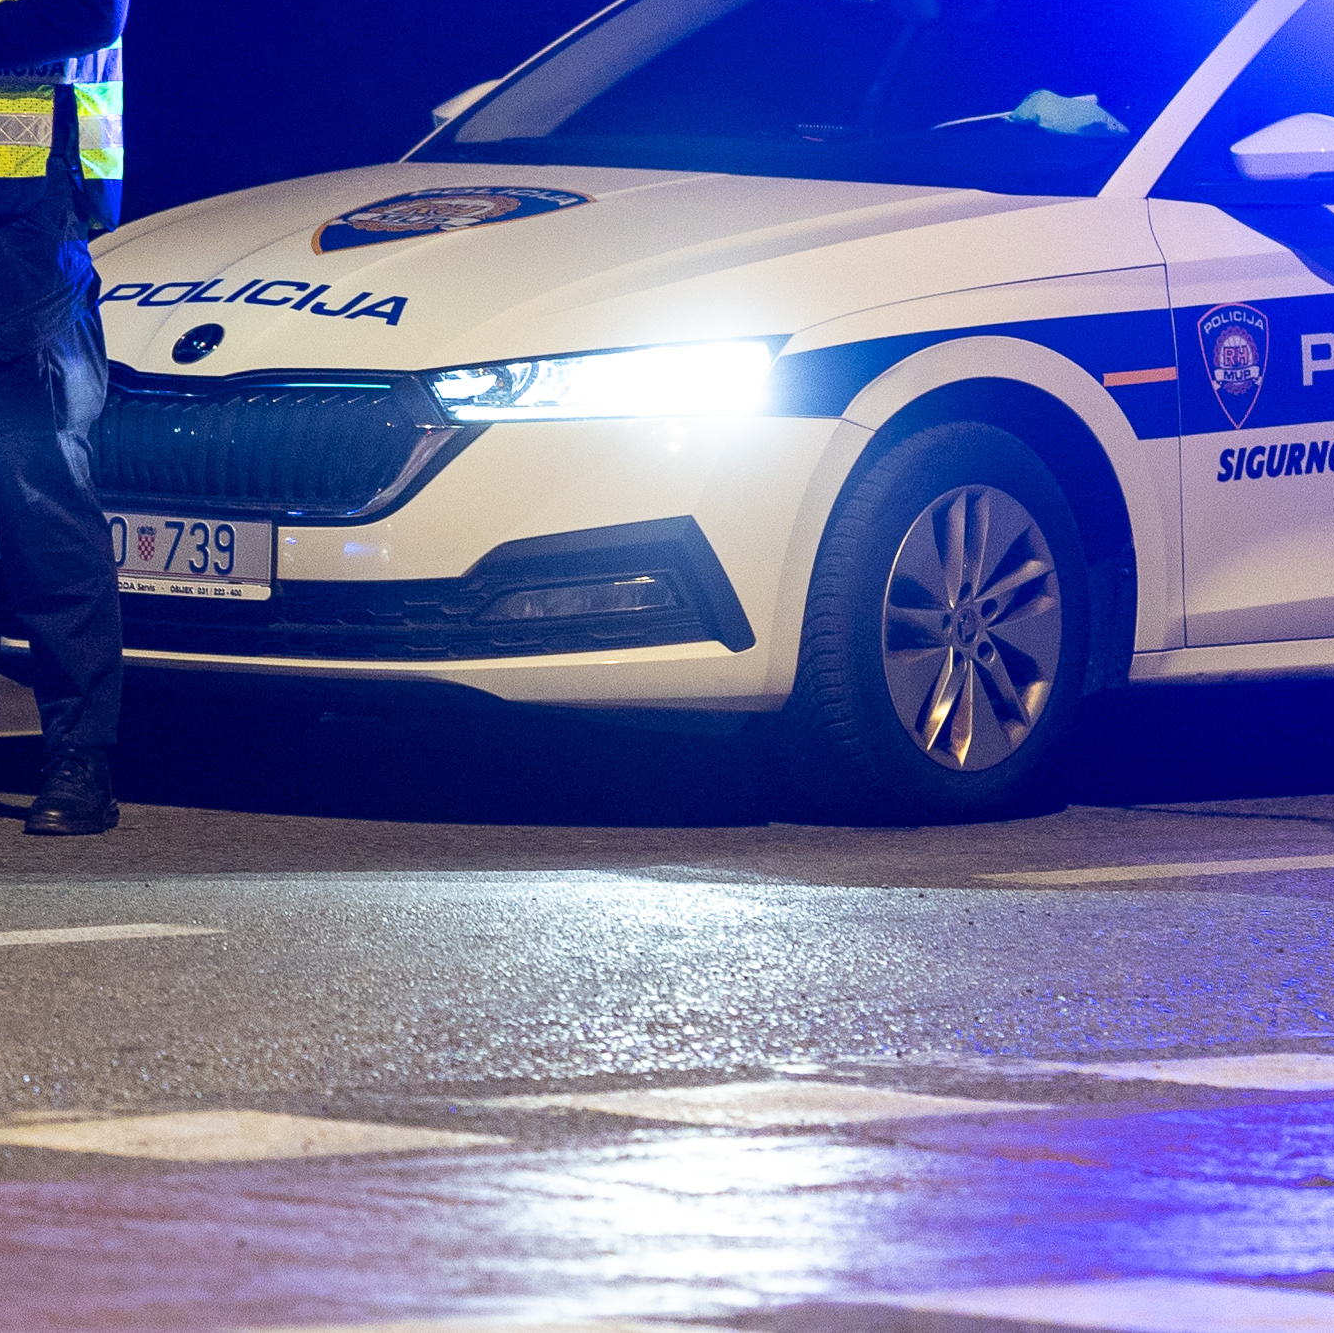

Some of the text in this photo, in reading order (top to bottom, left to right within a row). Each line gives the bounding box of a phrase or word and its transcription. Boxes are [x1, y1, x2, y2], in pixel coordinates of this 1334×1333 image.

[98, 278, 409, 326] POLICIJA
[1203, 310, 1264, 334] POLICIJA
[1223, 347, 1248, 367] RH
[1223, 368, 1251, 381] MUP
[164, 520, 236, 575] 739
